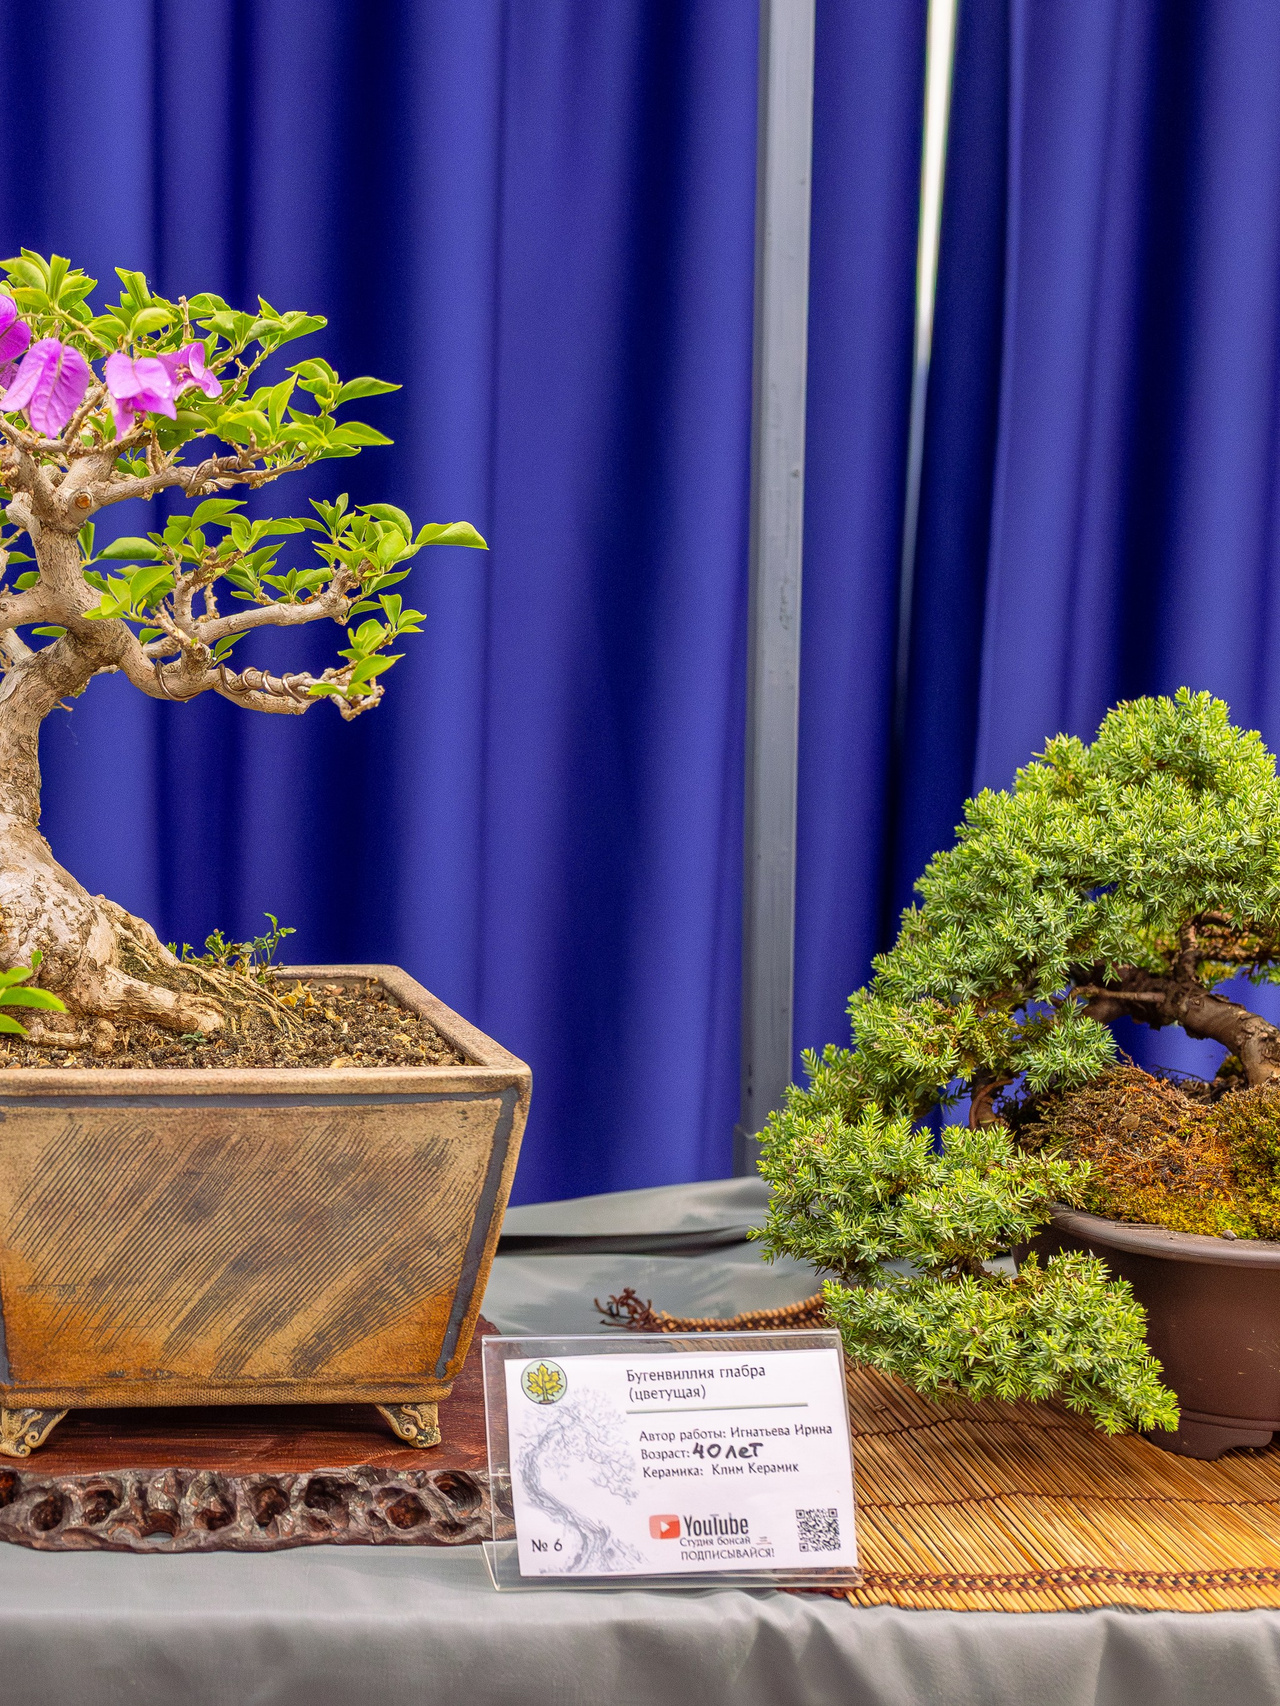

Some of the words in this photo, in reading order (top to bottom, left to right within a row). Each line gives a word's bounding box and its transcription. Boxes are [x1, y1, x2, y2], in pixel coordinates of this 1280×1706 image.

[626, 1369, 715, 1384] Бугенвиллия
[719, 1364, 766, 1380] глабра
[628, 1384, 706, 1402] (цветущая)
[639, 1431, 676, 1444] Автор
[679, 1427, 726, 1443] работы:
[729, 1425, 791, 1438] Игнатьева
[793, 1423, 833, 1436] Ирина
[640, 1449, 690, 1461] Возраст:
[692, 1442, 722, 1460] 40
[725, 1441, 764, 1460] лет
[642, 1466, 704, 1480] Керамика:
[711, 1464, 744, 1477] Клим
[747, 1462, 800, 1475] Керамик
[682, 1513, 750, 1537] YouTube
[553, 1537, 563, 1552] 6
[679, 1536, 715, 1548] Студия
[717, 1534, 751, 1546] бонсай
[680, 1547, 776, 1562] ПОДПИСЫВАЙСЯ!
